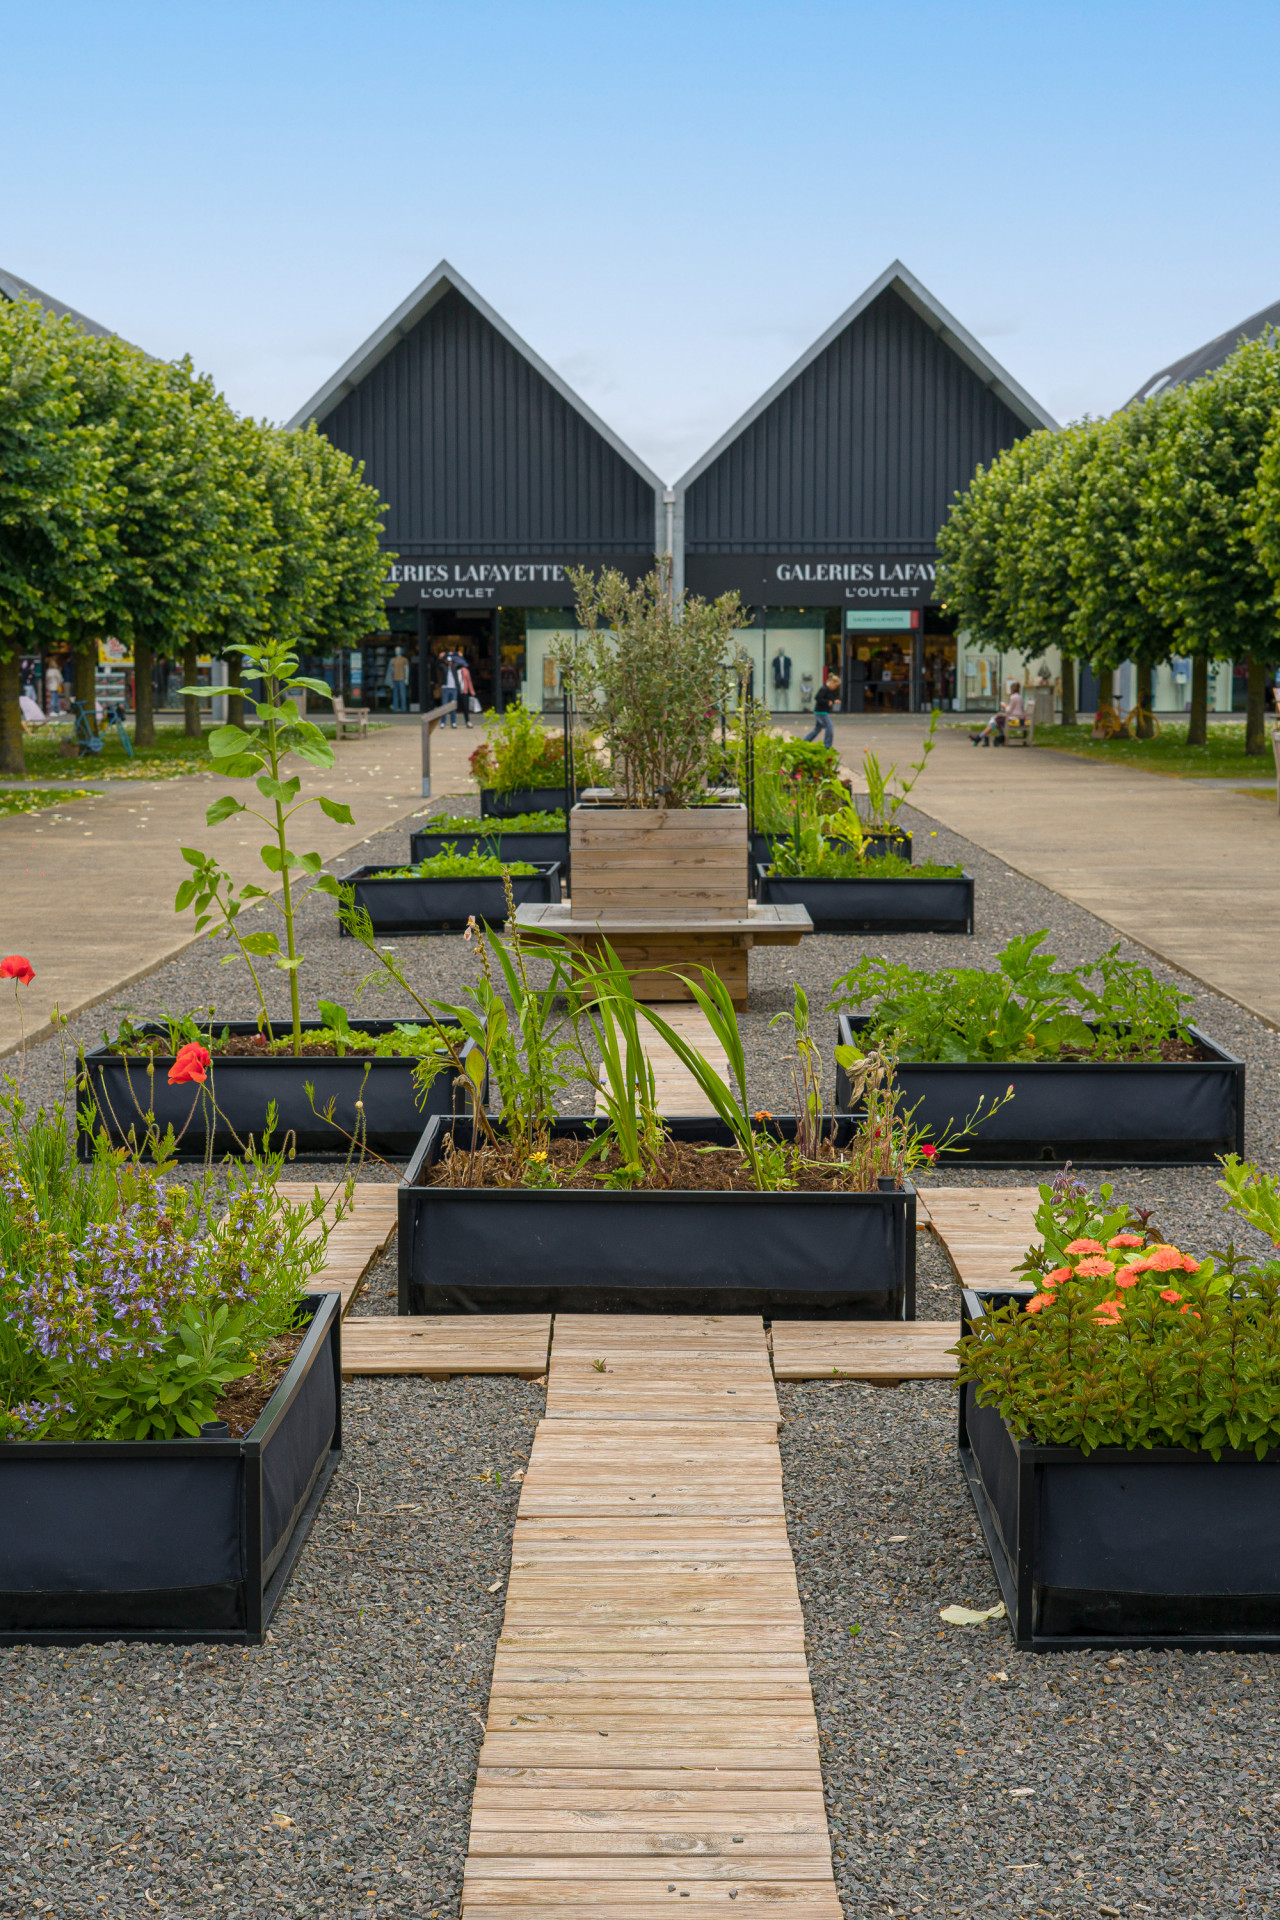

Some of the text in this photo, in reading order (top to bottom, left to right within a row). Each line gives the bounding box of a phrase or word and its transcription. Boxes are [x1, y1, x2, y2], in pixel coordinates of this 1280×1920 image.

[454, 565, 565, 582] LAFAYETTE
[776, 564, 940, 581] GALERIES LAFAY
[420, 588, 495, 598] L'OUTLET
[845, 587, 920, 598] L'OUTLET
